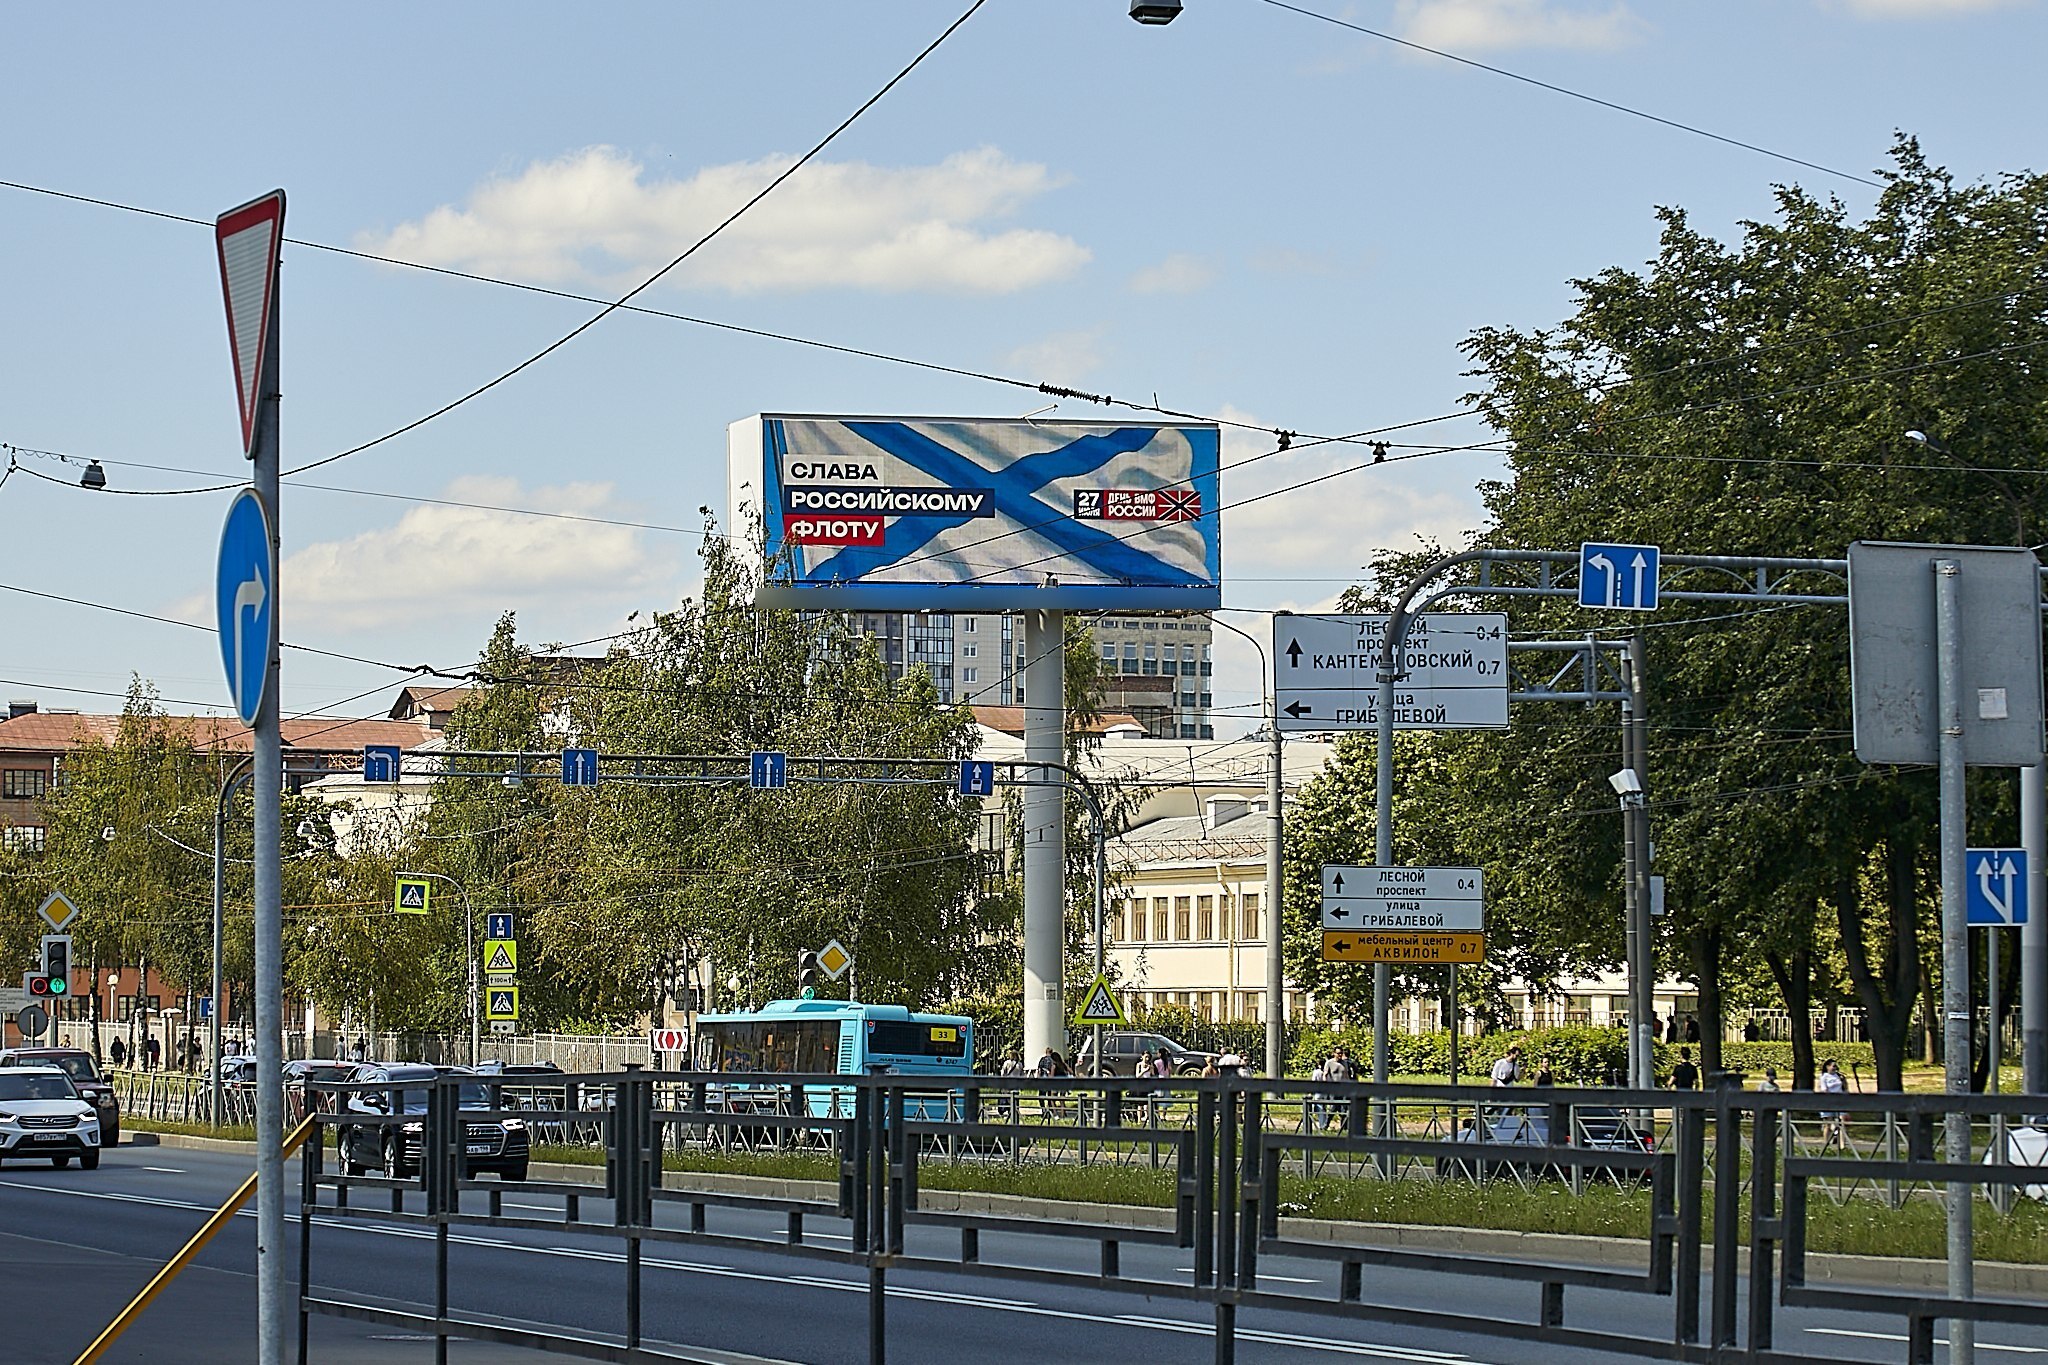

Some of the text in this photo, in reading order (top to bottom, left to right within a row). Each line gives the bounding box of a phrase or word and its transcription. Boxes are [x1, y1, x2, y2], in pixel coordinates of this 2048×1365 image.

[791, 463, 878, 479] СЛАВА
[791, 489, 984, 511] РОССИЙСКОМУ
[1078, 492, 1099, 506] 27
[1108, 492, 1156, 504] ДЕНЬ ВМФ
[1108, 505, 1156, 517] РОССИИ
[791, 520, 879, 538] ФЛОТУ
[1359, 617, 1427, 635] ЛЕСОЙ
[1357, 638, 1429, 653] проект
[1313, 650, 1473, 669] КАНТЕМОВСКИЙ
[1367, 694, 1414, 708] уца
[1336, 704, 1446, 723] ГРИБЛЕВОЙ
[1379, 869, 1425, 882] ЛЕСНОЙ
[1376, 886, 1427, 897] проспект
[1386, 902, 1420, 912] улица
[1362, 913, 1443, 926] ГРИБАЛЕВОЙ
[1358, 935, 1454, 948] мебельный центр
[1373, 948, 1439, 958] АКВИЛОН
[938, 1031, 948, 1039] 33
